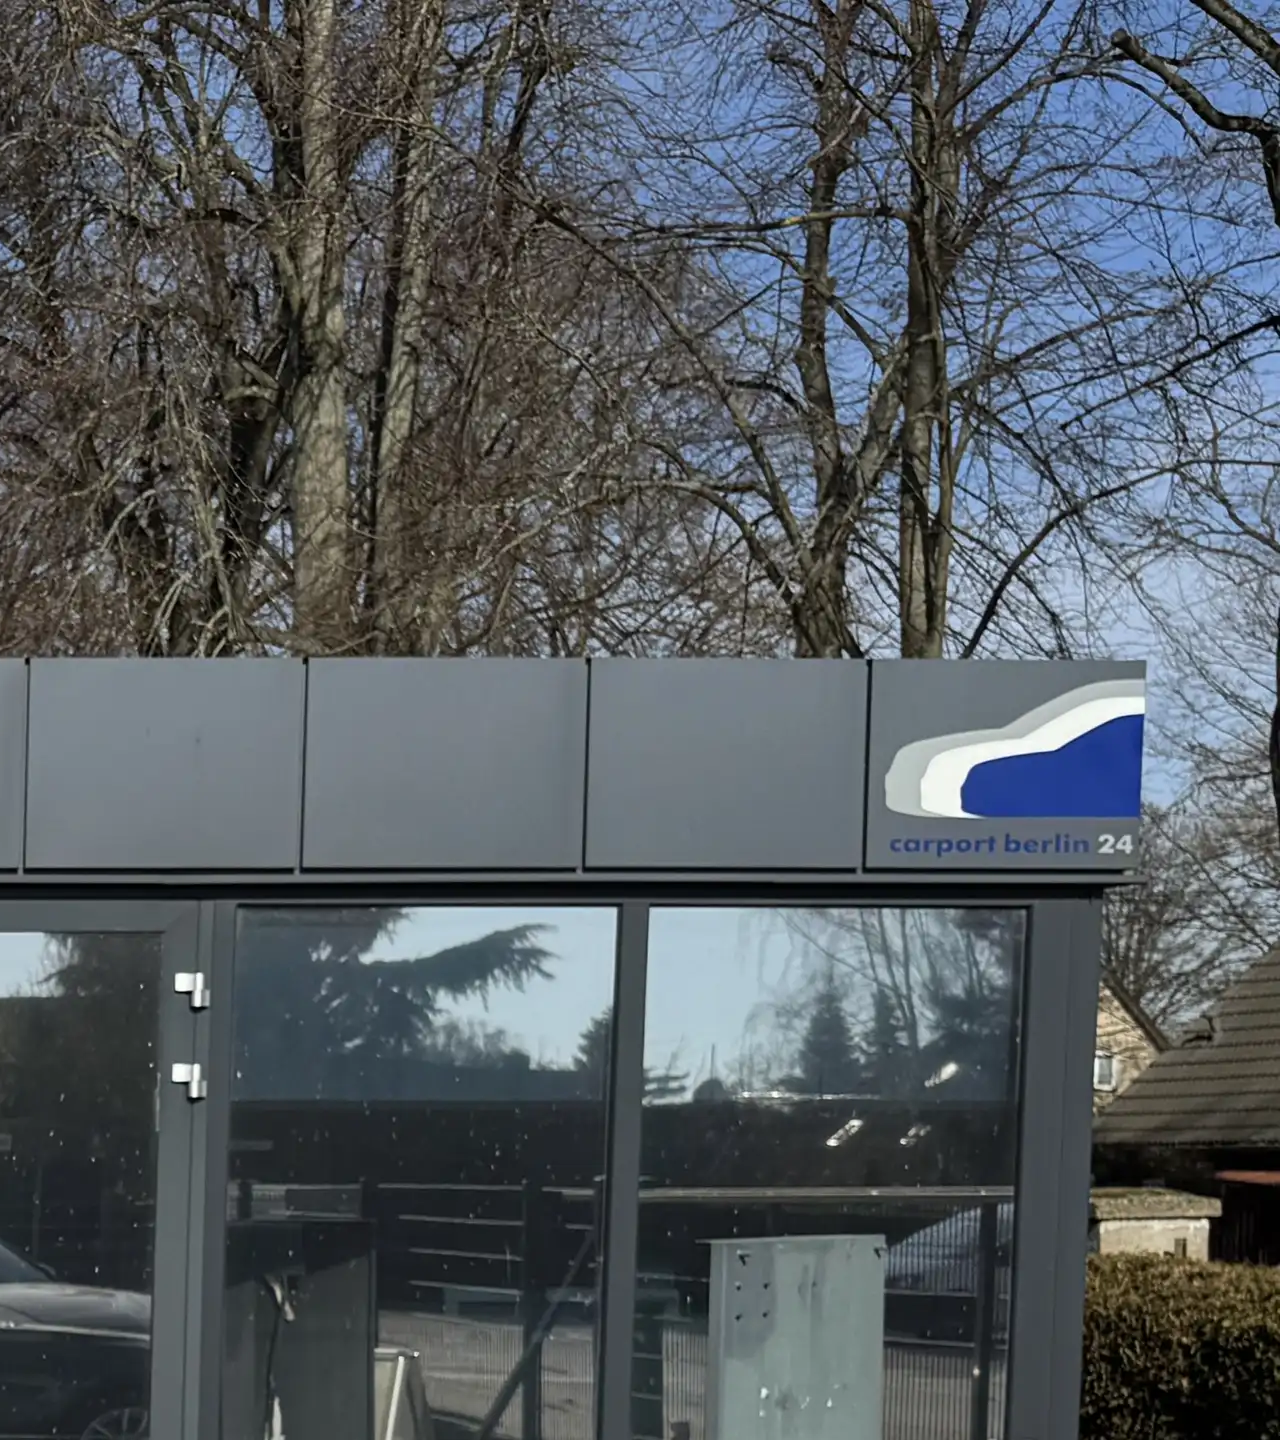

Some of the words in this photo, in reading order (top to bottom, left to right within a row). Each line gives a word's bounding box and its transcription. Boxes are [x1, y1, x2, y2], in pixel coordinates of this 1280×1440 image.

[889, 833, 996, 858] carport
[1004, 833, 1090, 855] berlin
[1097, 833, 1134, 855] 24
